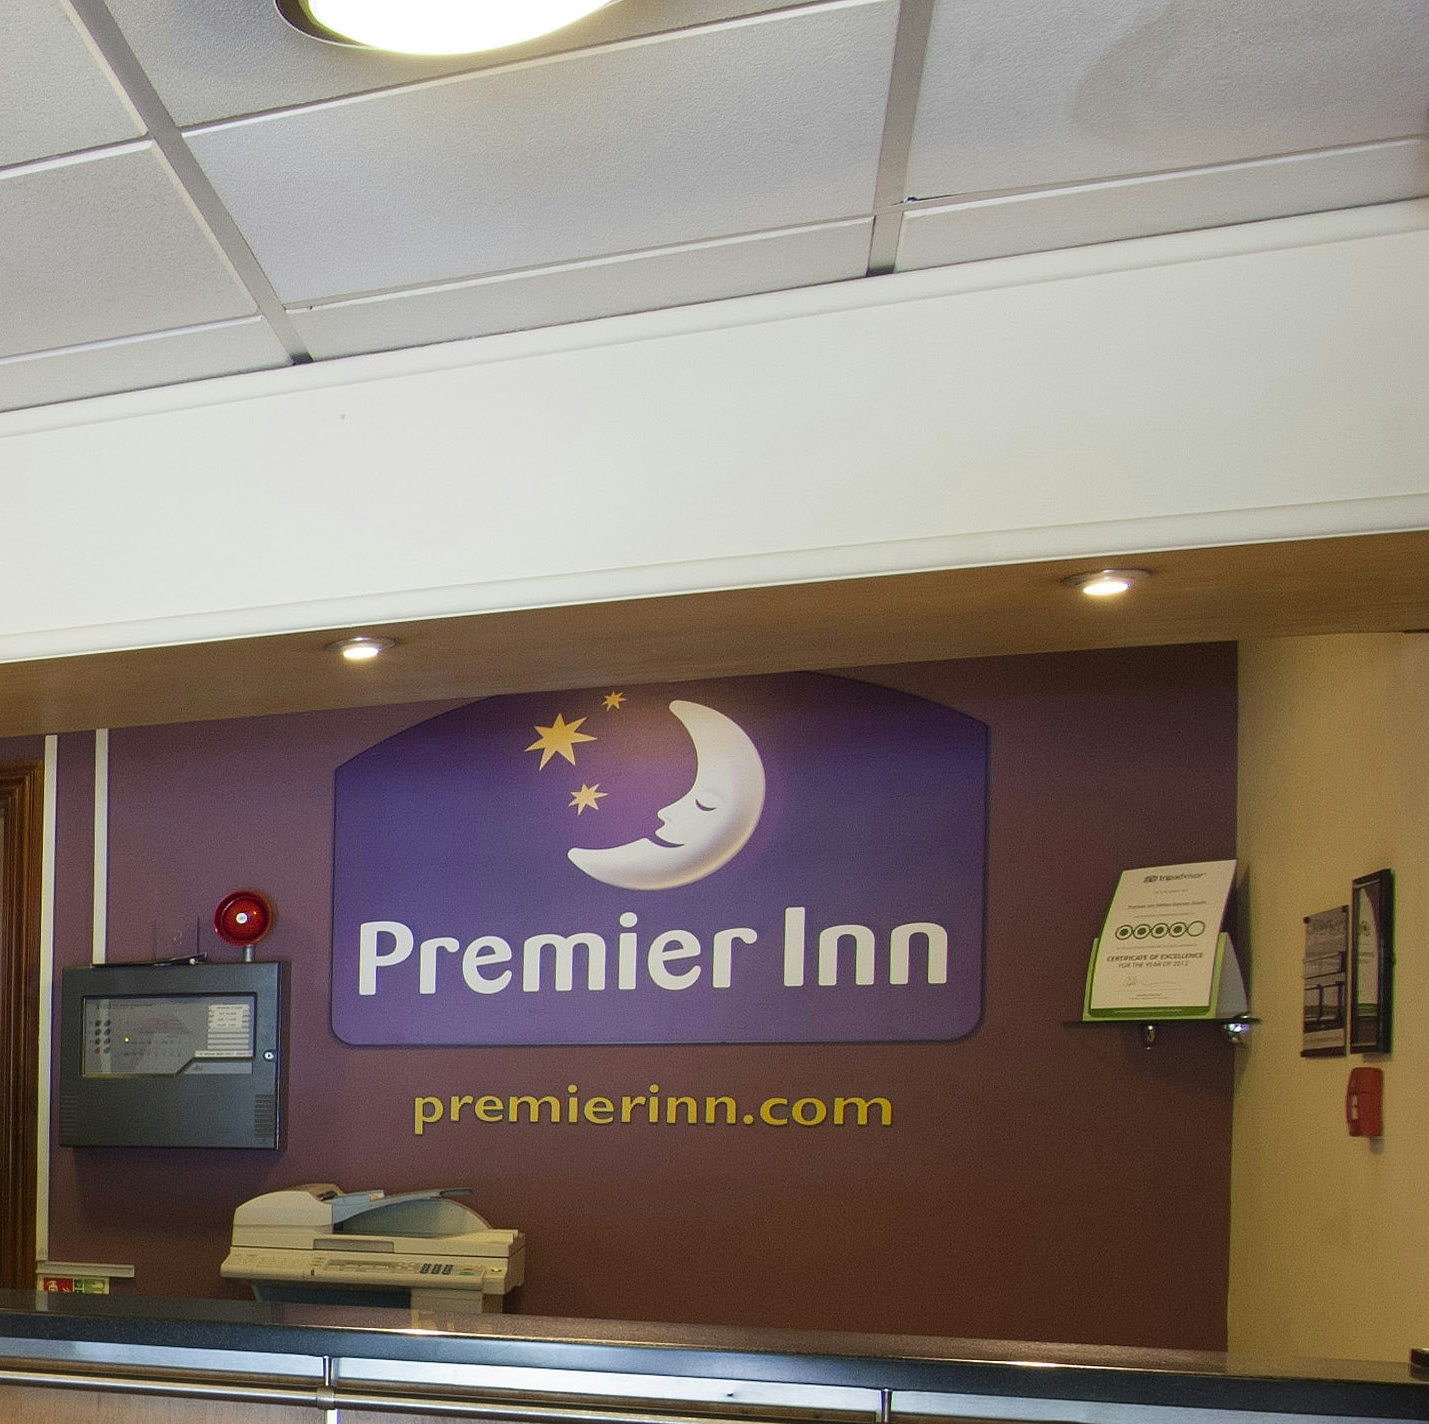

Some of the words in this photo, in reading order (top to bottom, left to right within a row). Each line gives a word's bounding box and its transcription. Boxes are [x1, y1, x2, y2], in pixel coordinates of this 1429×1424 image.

[358, 912, 758, 995] Premier
[783, 906, 949, 988] Inn
[1107, 954, 1147, 962] CERTIFICATE
[1160, 952, 1203, 960] EXCELLENCE
[414, 1084, 894, 1136] premierinn.com
